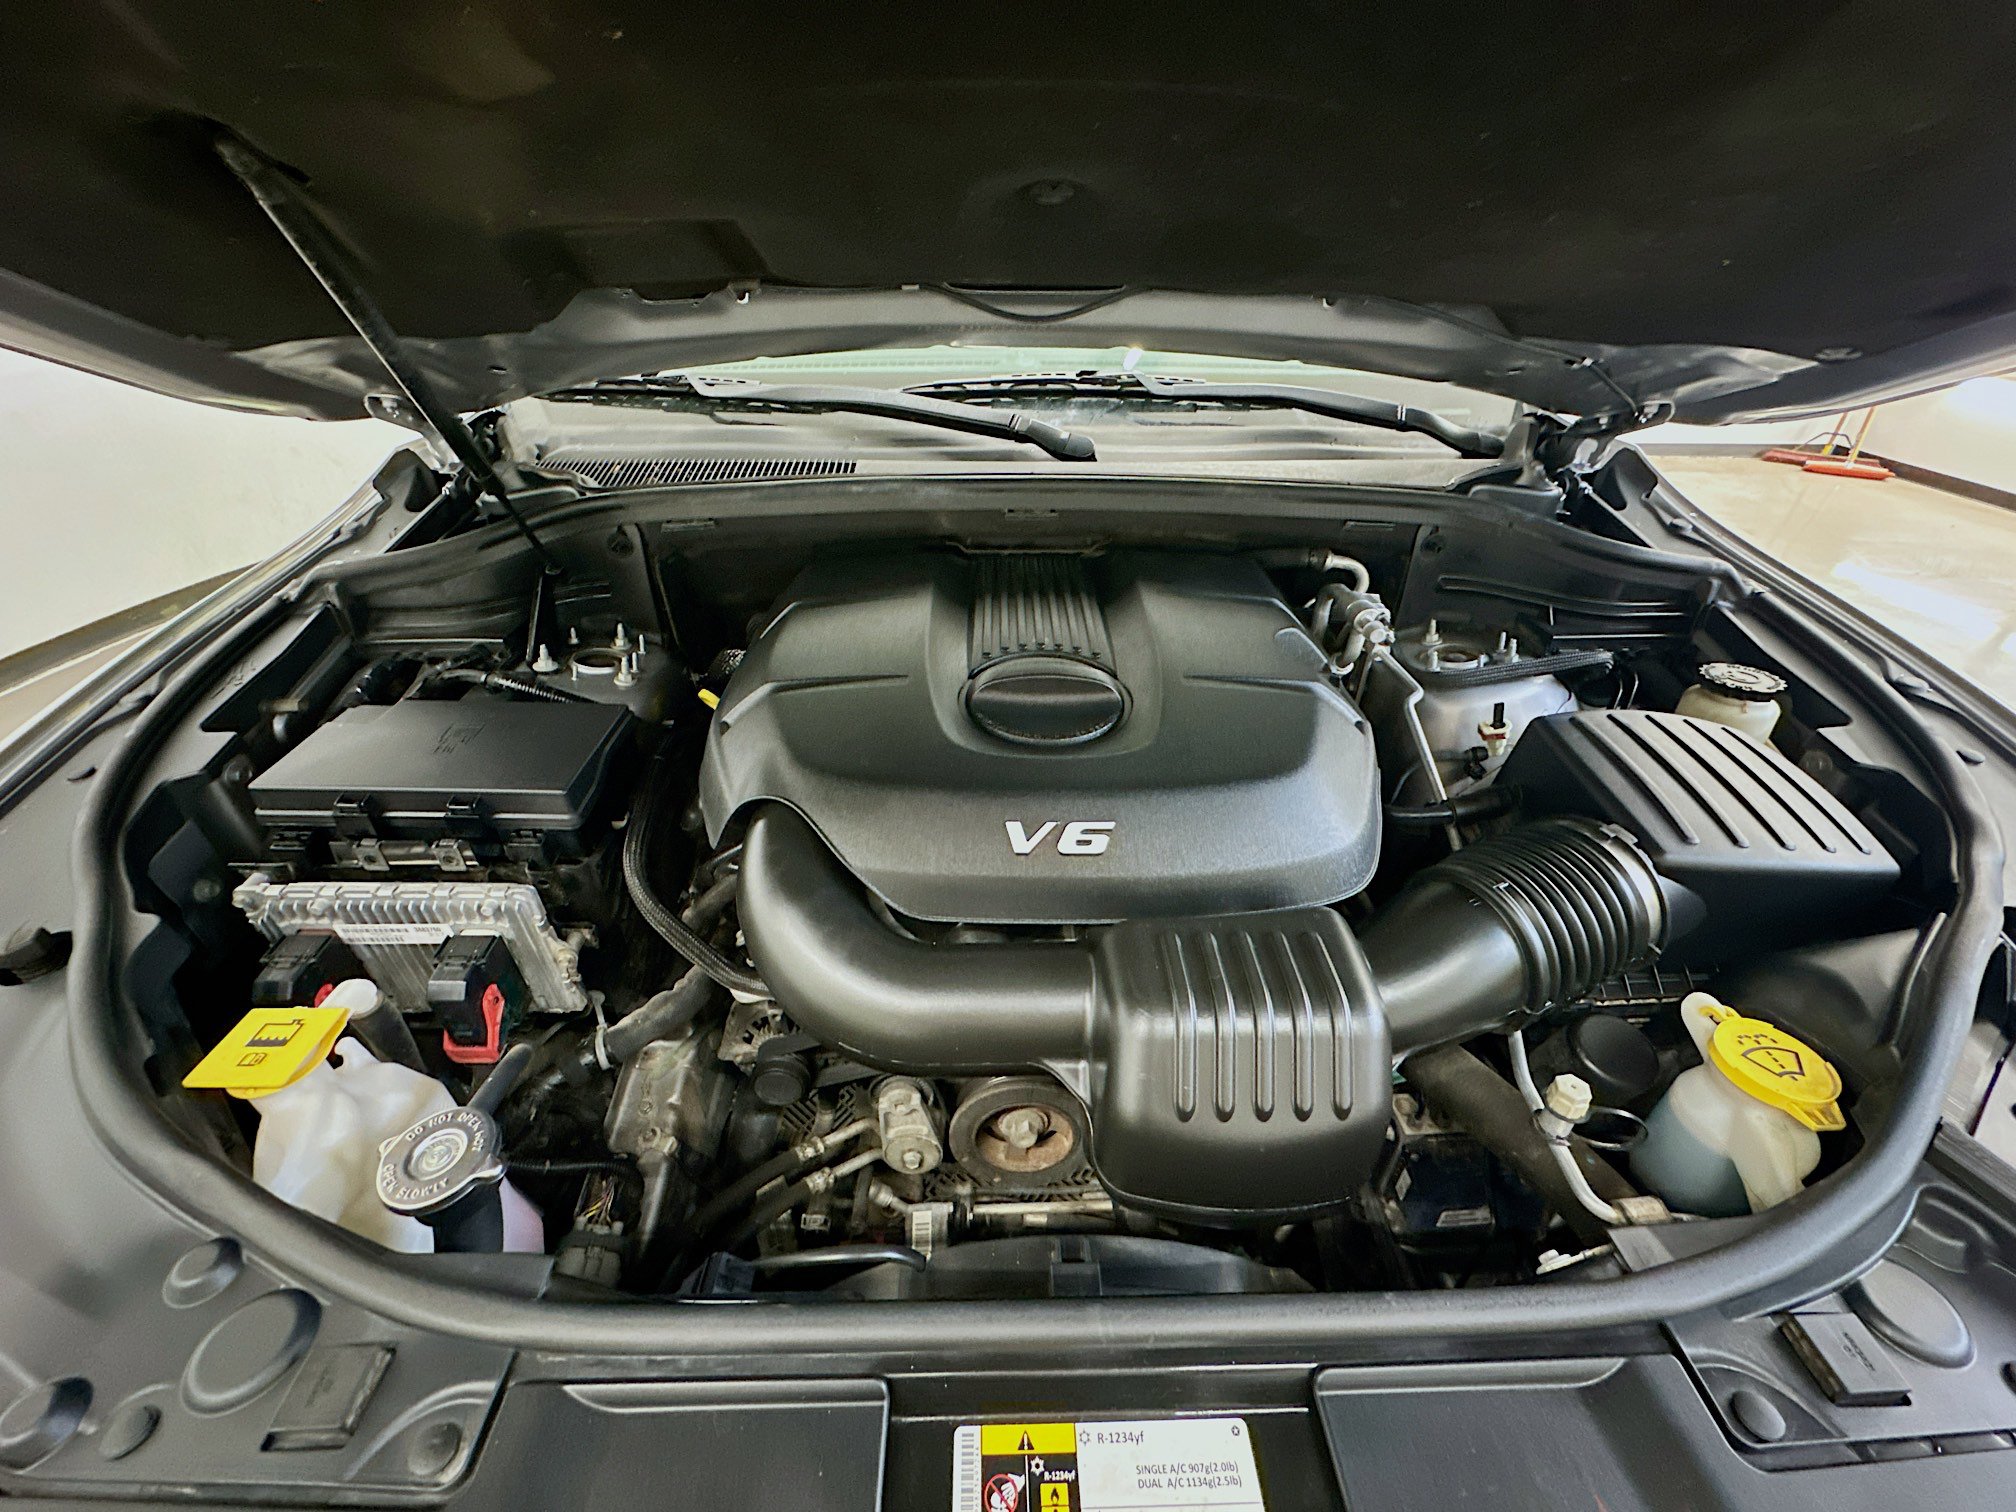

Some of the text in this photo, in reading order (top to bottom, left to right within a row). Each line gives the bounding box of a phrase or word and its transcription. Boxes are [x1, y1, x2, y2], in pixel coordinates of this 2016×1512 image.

[1005, 820, 1116, 855] V6
[405, 1125, 424, 1141] DO
[428, 1113, 453, 1128] NOT
[457, 1112, 482, 1132] OPEN
[383, 1163, 449, 1200] OPEN SLOWLY
[1097, 1431, 1144, 1445] R-1234yf
[1044, 1469, 1076, 1482] R-1234yf
[1136, 1461, 1239, 1475] SINGLE A/C 907g(2.0lb)
[1138, 1475, 1242, 1490] DUAL A/C 1134g(2.5lb)
